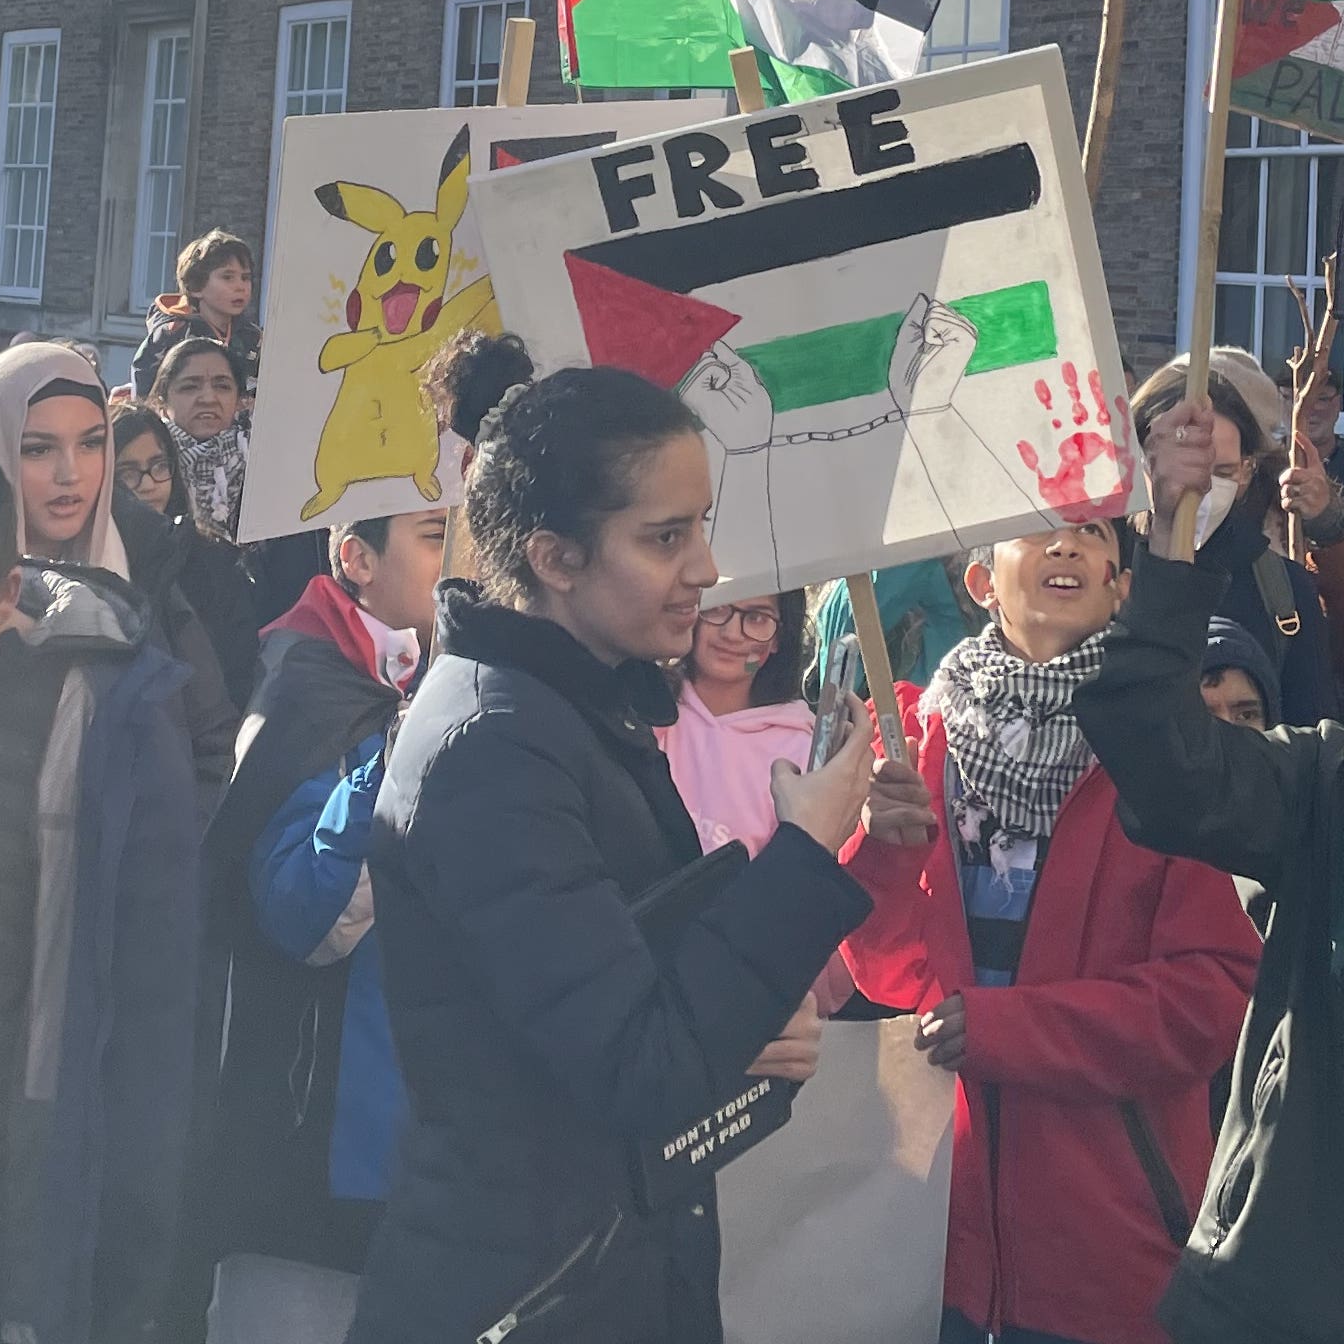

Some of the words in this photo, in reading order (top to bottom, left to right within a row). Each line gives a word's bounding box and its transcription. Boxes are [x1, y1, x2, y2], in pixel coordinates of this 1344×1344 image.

[592, 88, 916, 233] FREE
[663, 1116, 712, 1161] DON'T
[715, 1078, 771, 1124] TOUCH
[690, 1136, 715, 1165] MY
[717, 1113, 751, 1145] PAD
